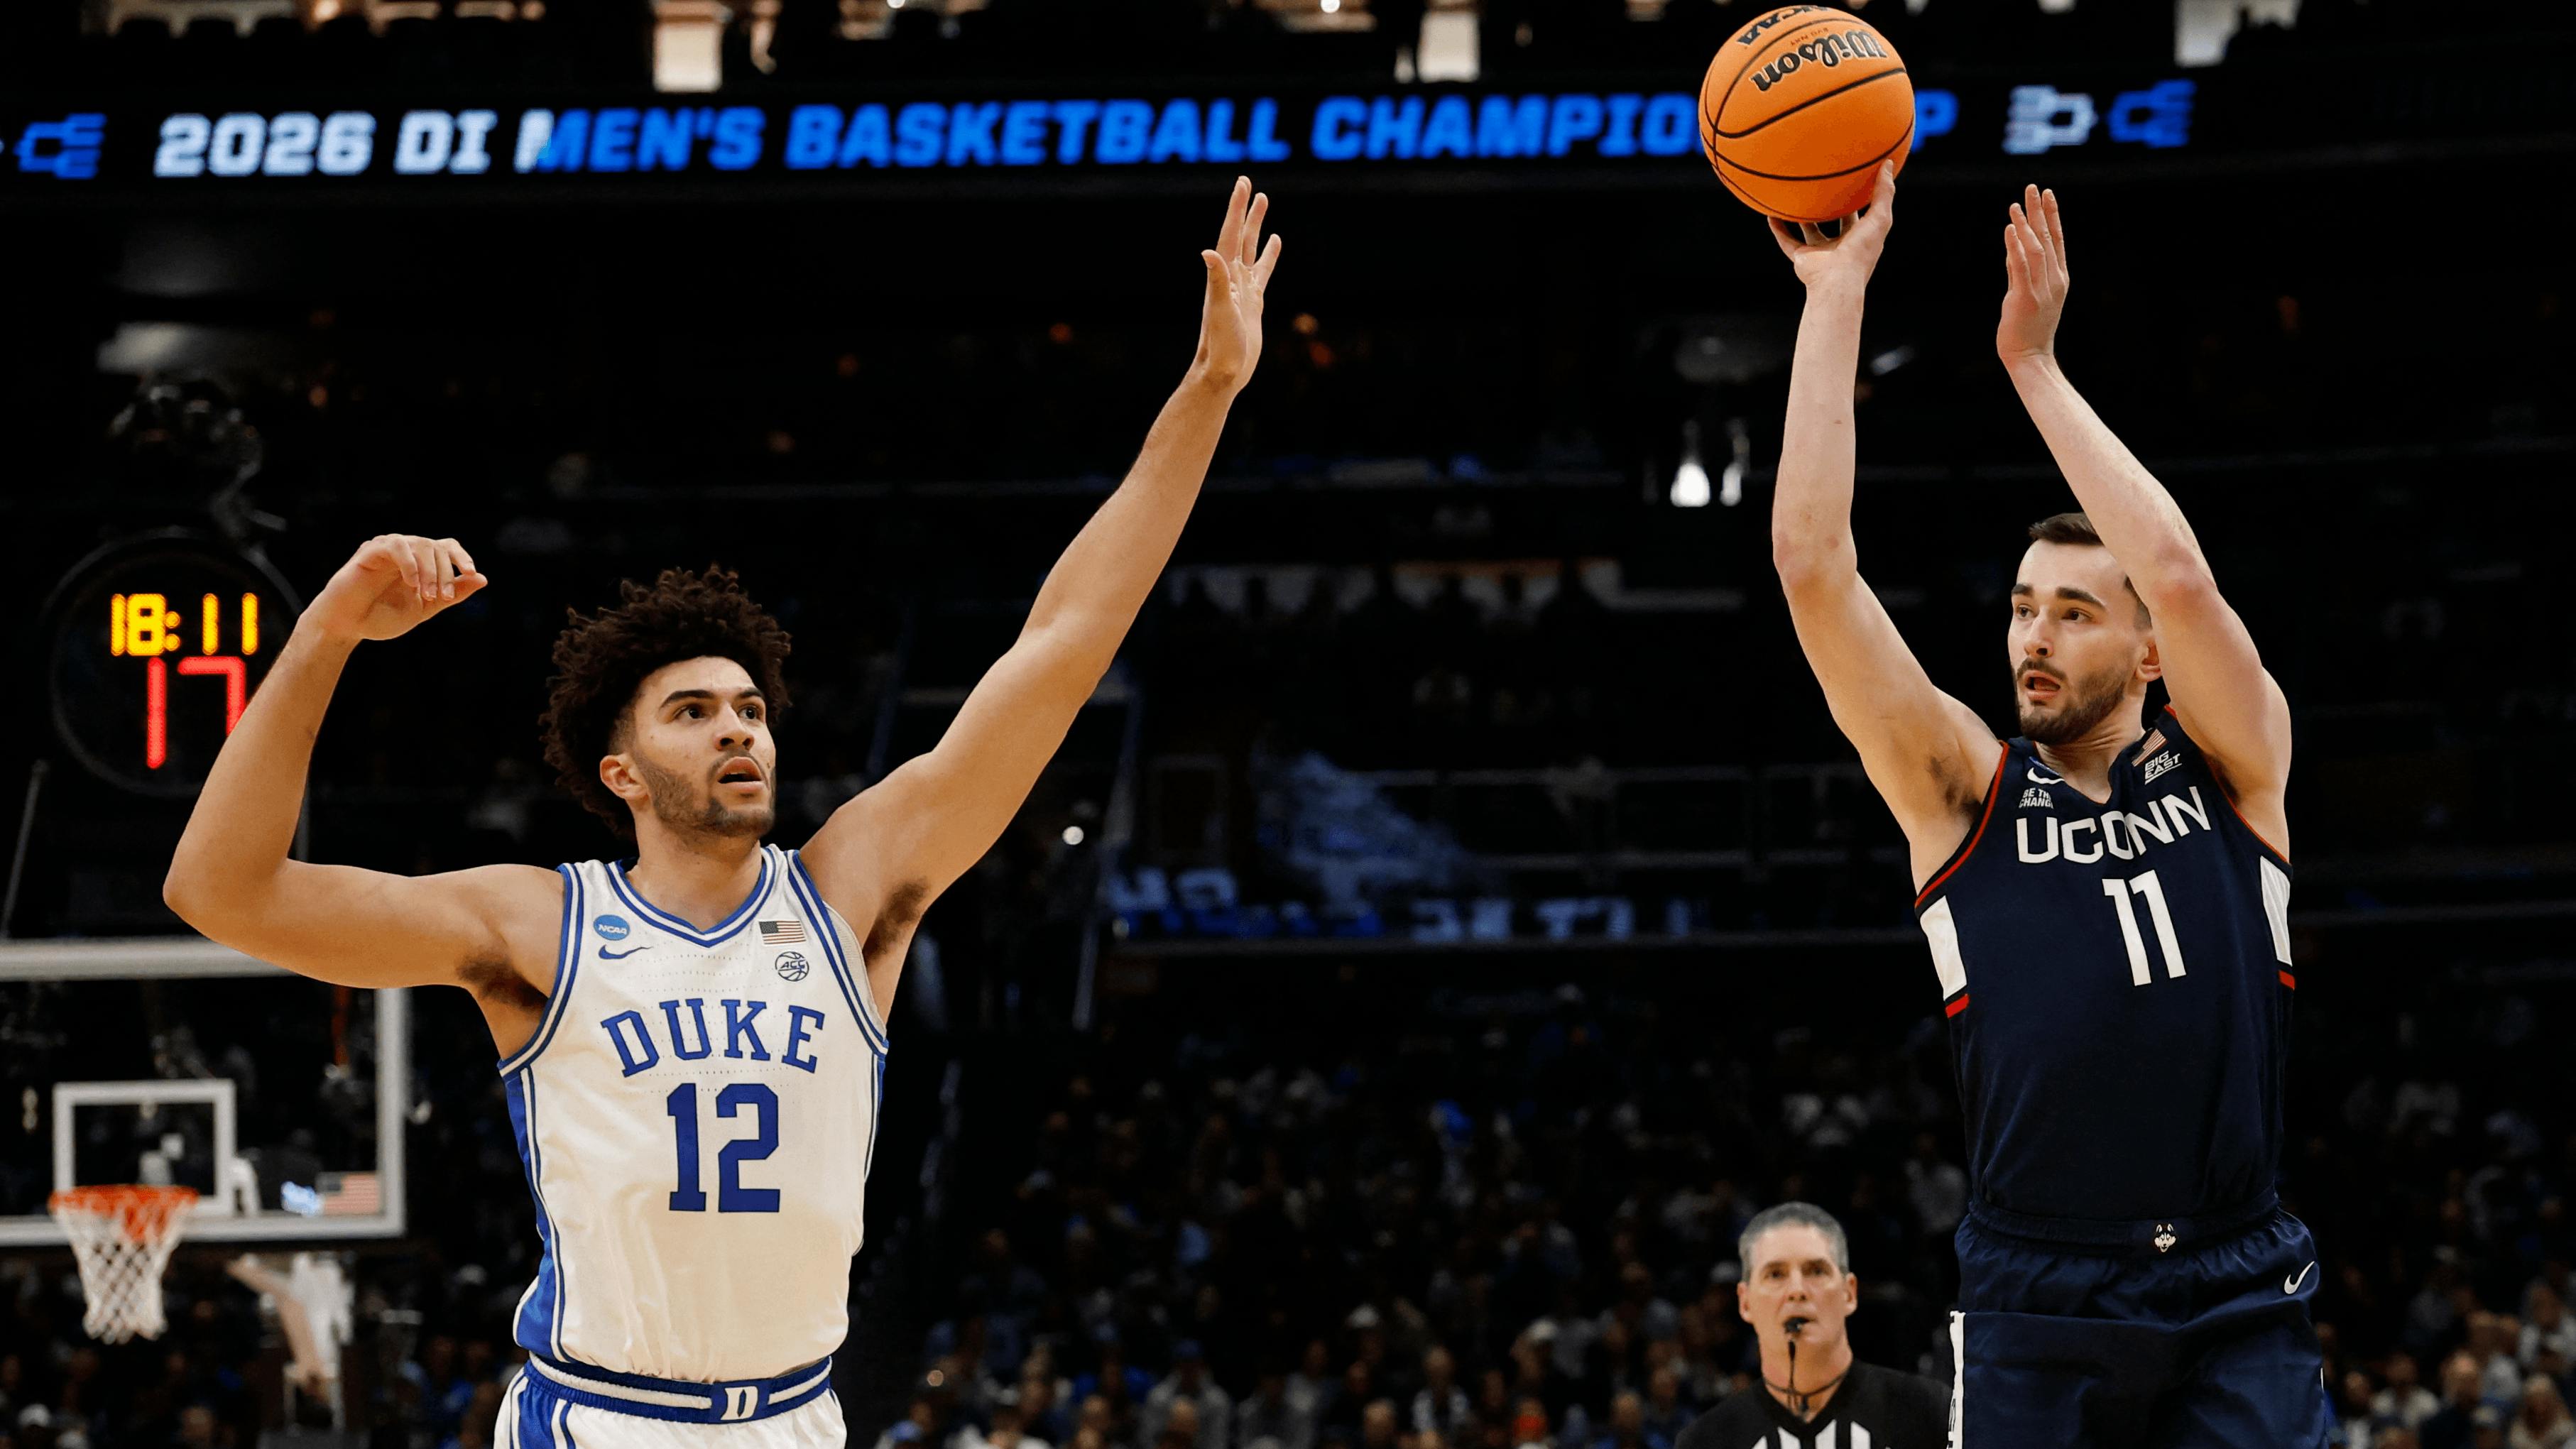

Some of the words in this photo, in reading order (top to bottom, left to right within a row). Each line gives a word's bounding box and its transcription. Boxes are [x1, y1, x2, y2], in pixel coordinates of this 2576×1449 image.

[1749, 31, 1888, 92] Wilson
[153, 111, 376, 177] 2026
[393, 109, 498, 174] DI
[514, 106, 765, 173] MEN'S
[785, 97, 1290, 168] BASKETBALL
[1311, 90, 1958, 158] CHAMPIOP
[111, 593, 258, 656] 18:11
[147, 656, 246, 769] 17
[2145, 750, 2169, 772] BIG
[2145, 753, 2181, 780] EAST
[2022, 787, 2036, 798] BE
[2016, 786, 2211, 863] UCONN
[599, 924, 627, 935] NCAA
[2102, 869, 2187, 987] 11
[780, 960, 806, 970] ACC
[600, 998, 825, 1078] DUKE
[667, 1083, 780, 1213] 12
[721, 1386, 758, 1420] D
